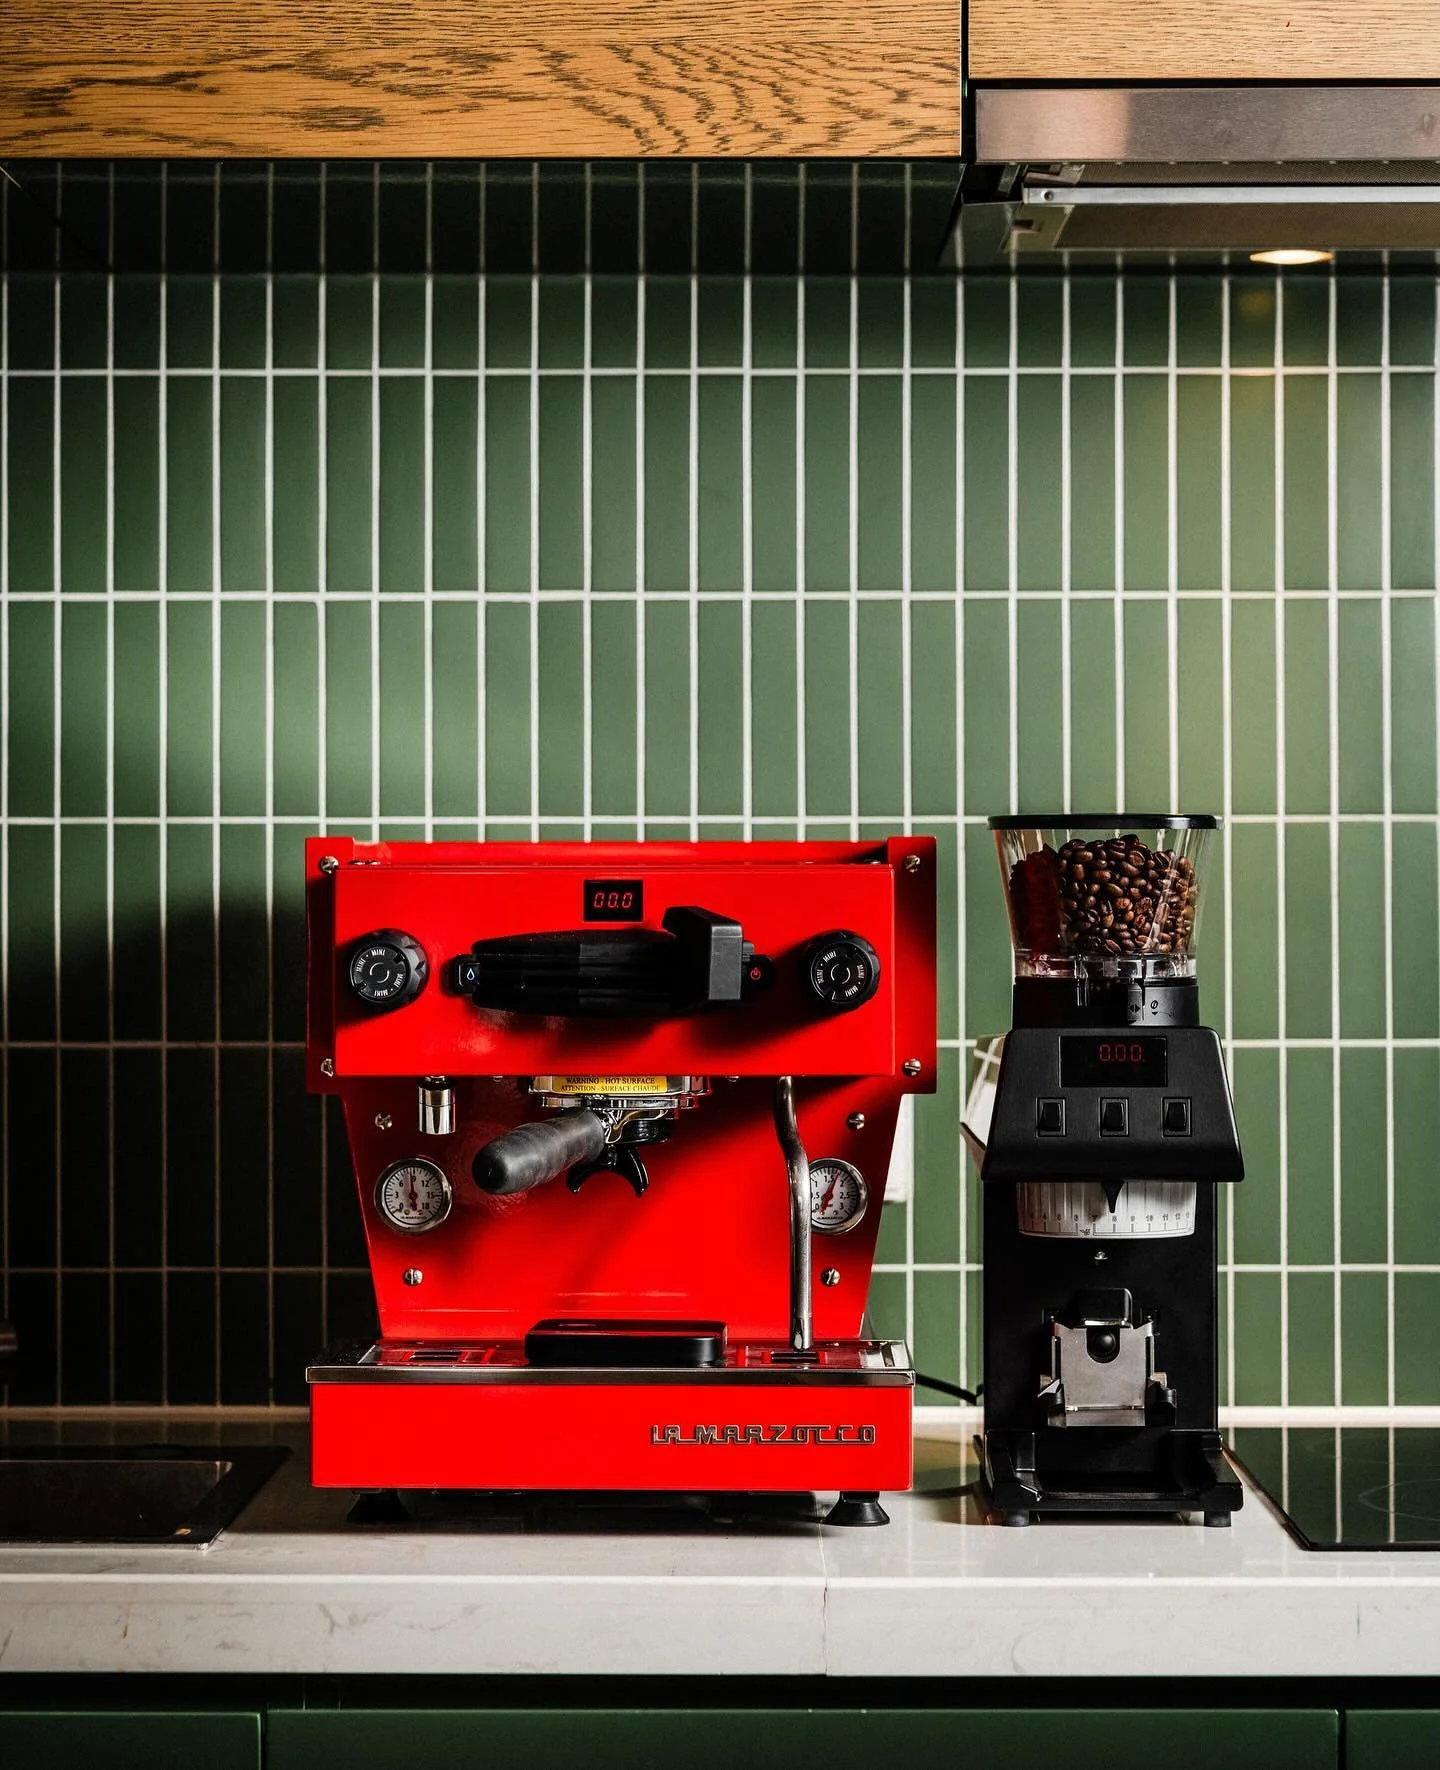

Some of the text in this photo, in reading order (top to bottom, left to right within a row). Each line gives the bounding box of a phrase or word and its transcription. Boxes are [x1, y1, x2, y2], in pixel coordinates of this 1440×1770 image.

[593, 892, 633, 909] 00.0
[371, 948, 386, 957] MINI
[823, 950, 837, 963] MINI
[566, 1077, 600, 1085] WARNING
[605, 1077, 621, 1085] HOT
[622, 1077, 655, 1085] SURFACE
[560, 1084, 597, 1092] ATTENTION
[601, 1084, 631, 1092] SURFACE
[631, 1084, 661, 1092] CHAUDE
[399, 1180, 404, 1188] 6
[421, 1180, 430, 1188] 12
[394, 1191, 399, 1199] 3
[426, 1191, 435, 1199] 15
[839, 1191, 850, 1200] 2,5
[399, 1202, 404, 1210] 0
[839, 1202, 844, 1210] 3
[652, 1424, 681, 1445] LA
